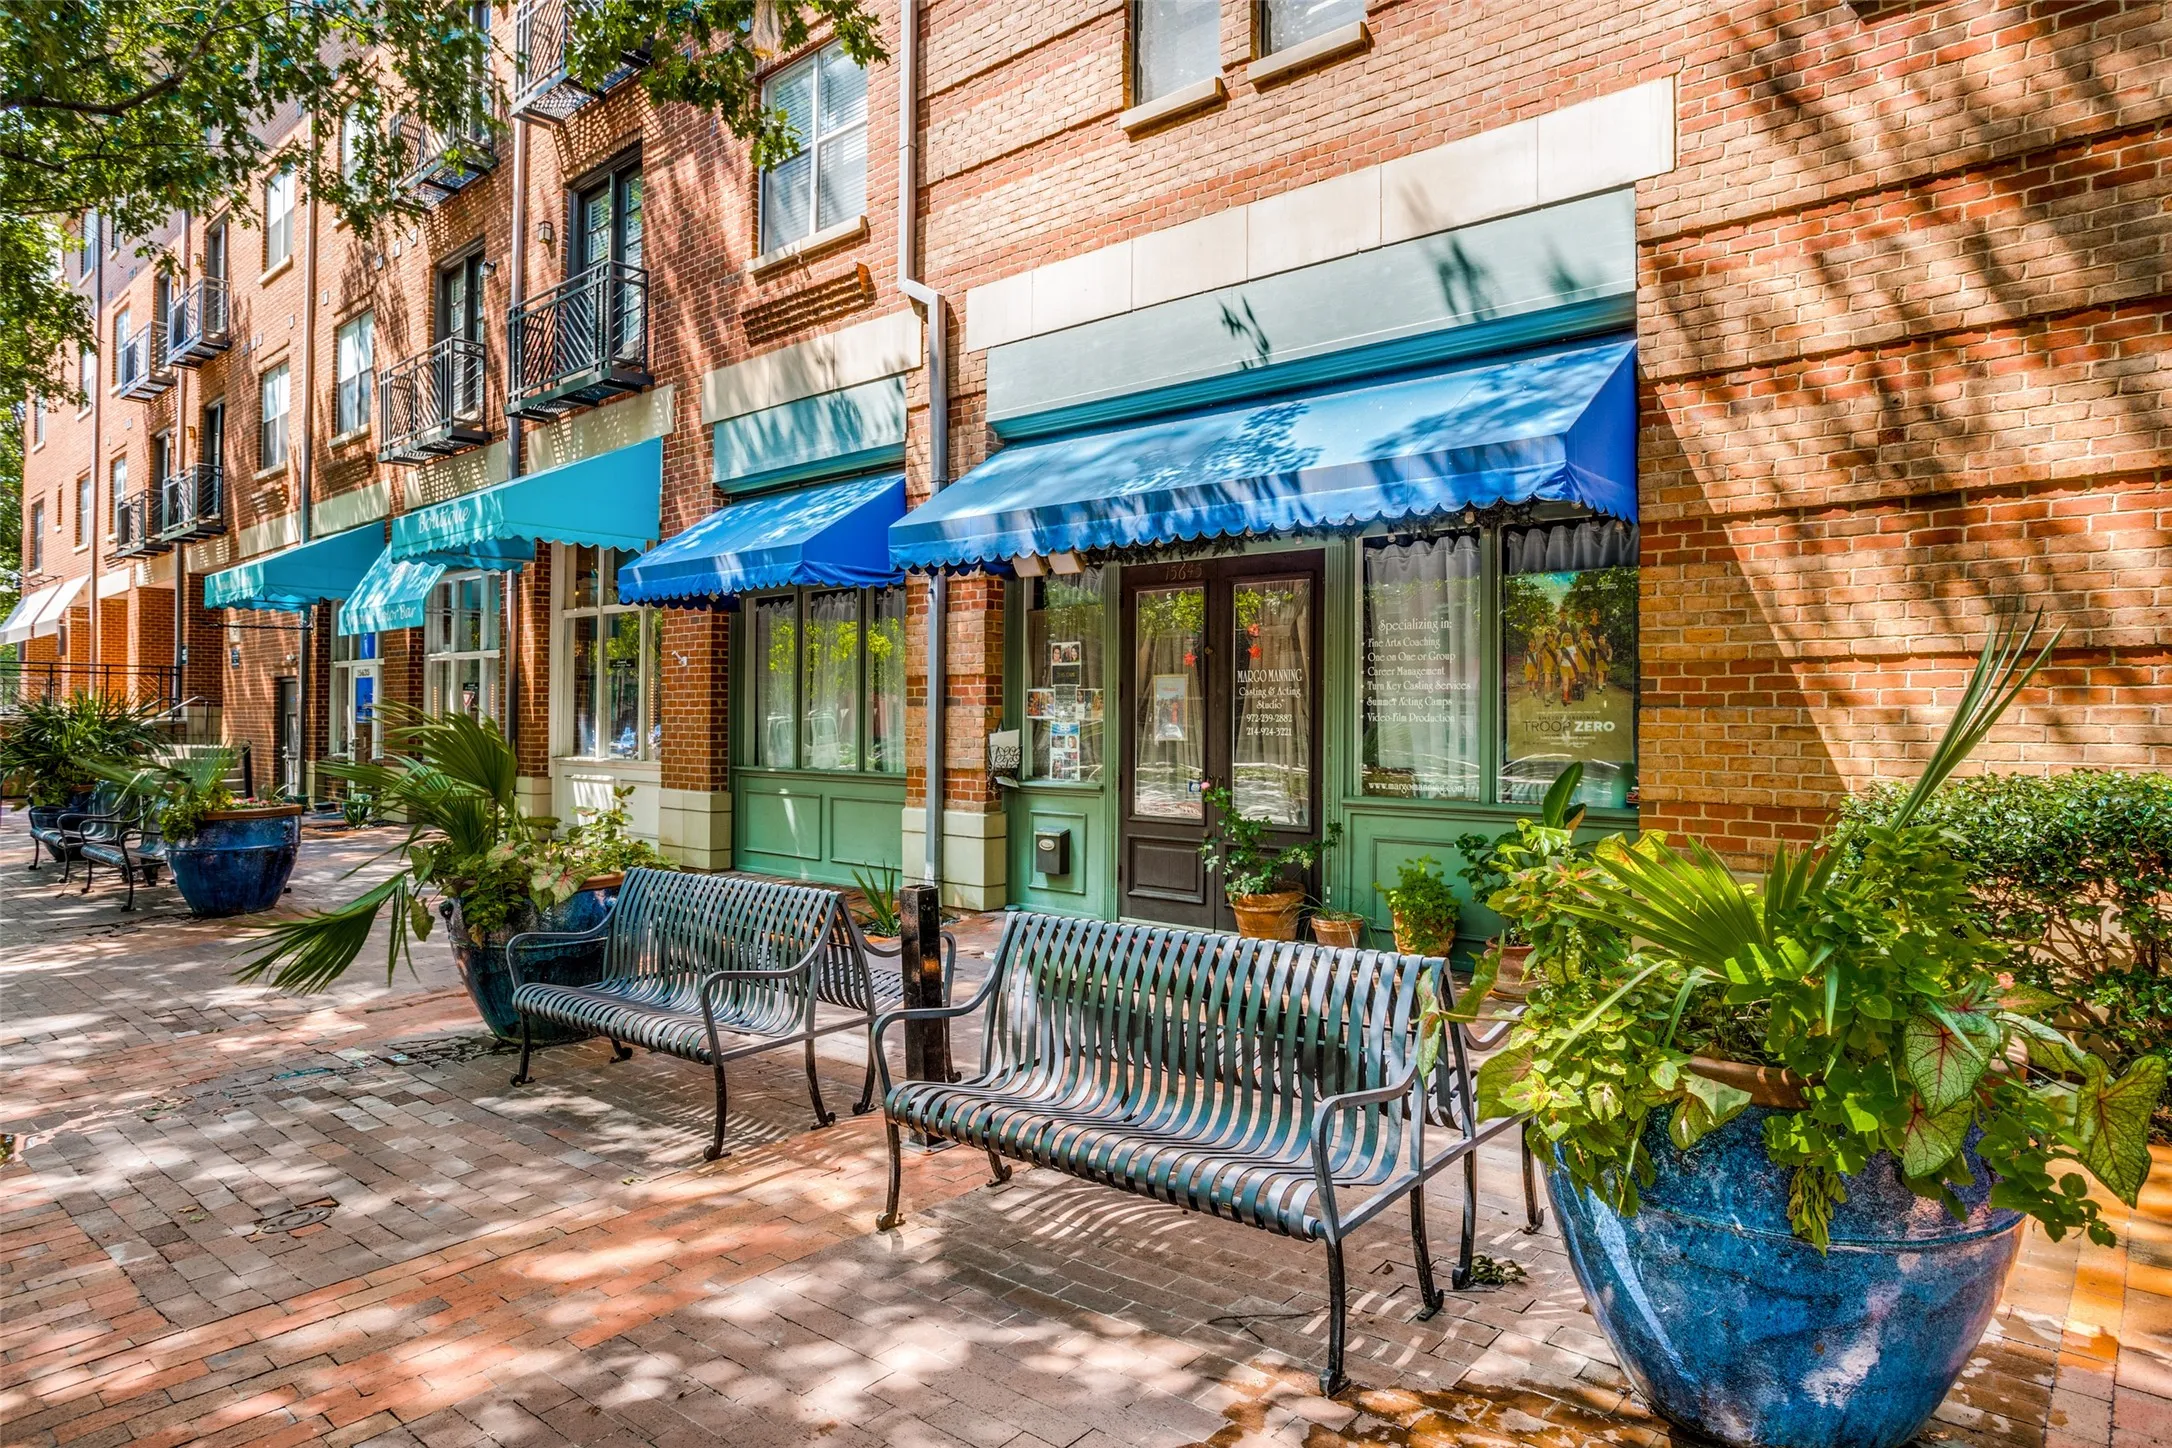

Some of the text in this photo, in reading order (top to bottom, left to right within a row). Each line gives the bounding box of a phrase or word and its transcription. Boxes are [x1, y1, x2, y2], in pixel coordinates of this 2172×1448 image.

[418, 506, 471, 534] Boutique
[1166, 562, 1202, 580] 15645
[399, 603, 416, 620] Bar
[1378, 617, 1452, 634] Specializing in:
[1368, 636, 1440, 649] Fine Arts Coaching
[1367, 652, 1385, 662] One
[1398, 652, 1416, 661] One
[1428, 651, 1456, 663] Group
[1237, 669, 1302, 683] MARGO MANNING
[1367, 666, 1445, 678] Career Management
[1239, 686, 1301, 698] Casting & Acting
[1367, 680, 1471, 693] Turn Key Casting Services
[1256, 699, 1282, 709] Studio
[1366, 696, 1452, 709] Summer Acting Camps
[1246, 713, 1293, 723] 972-239-2882
[1367, 712, 1455, 722] Video-Film Production
[1246, 727, 1292, 736] 214-924-3221
[1522, 720, 1615, 732] TROOP ZERO
